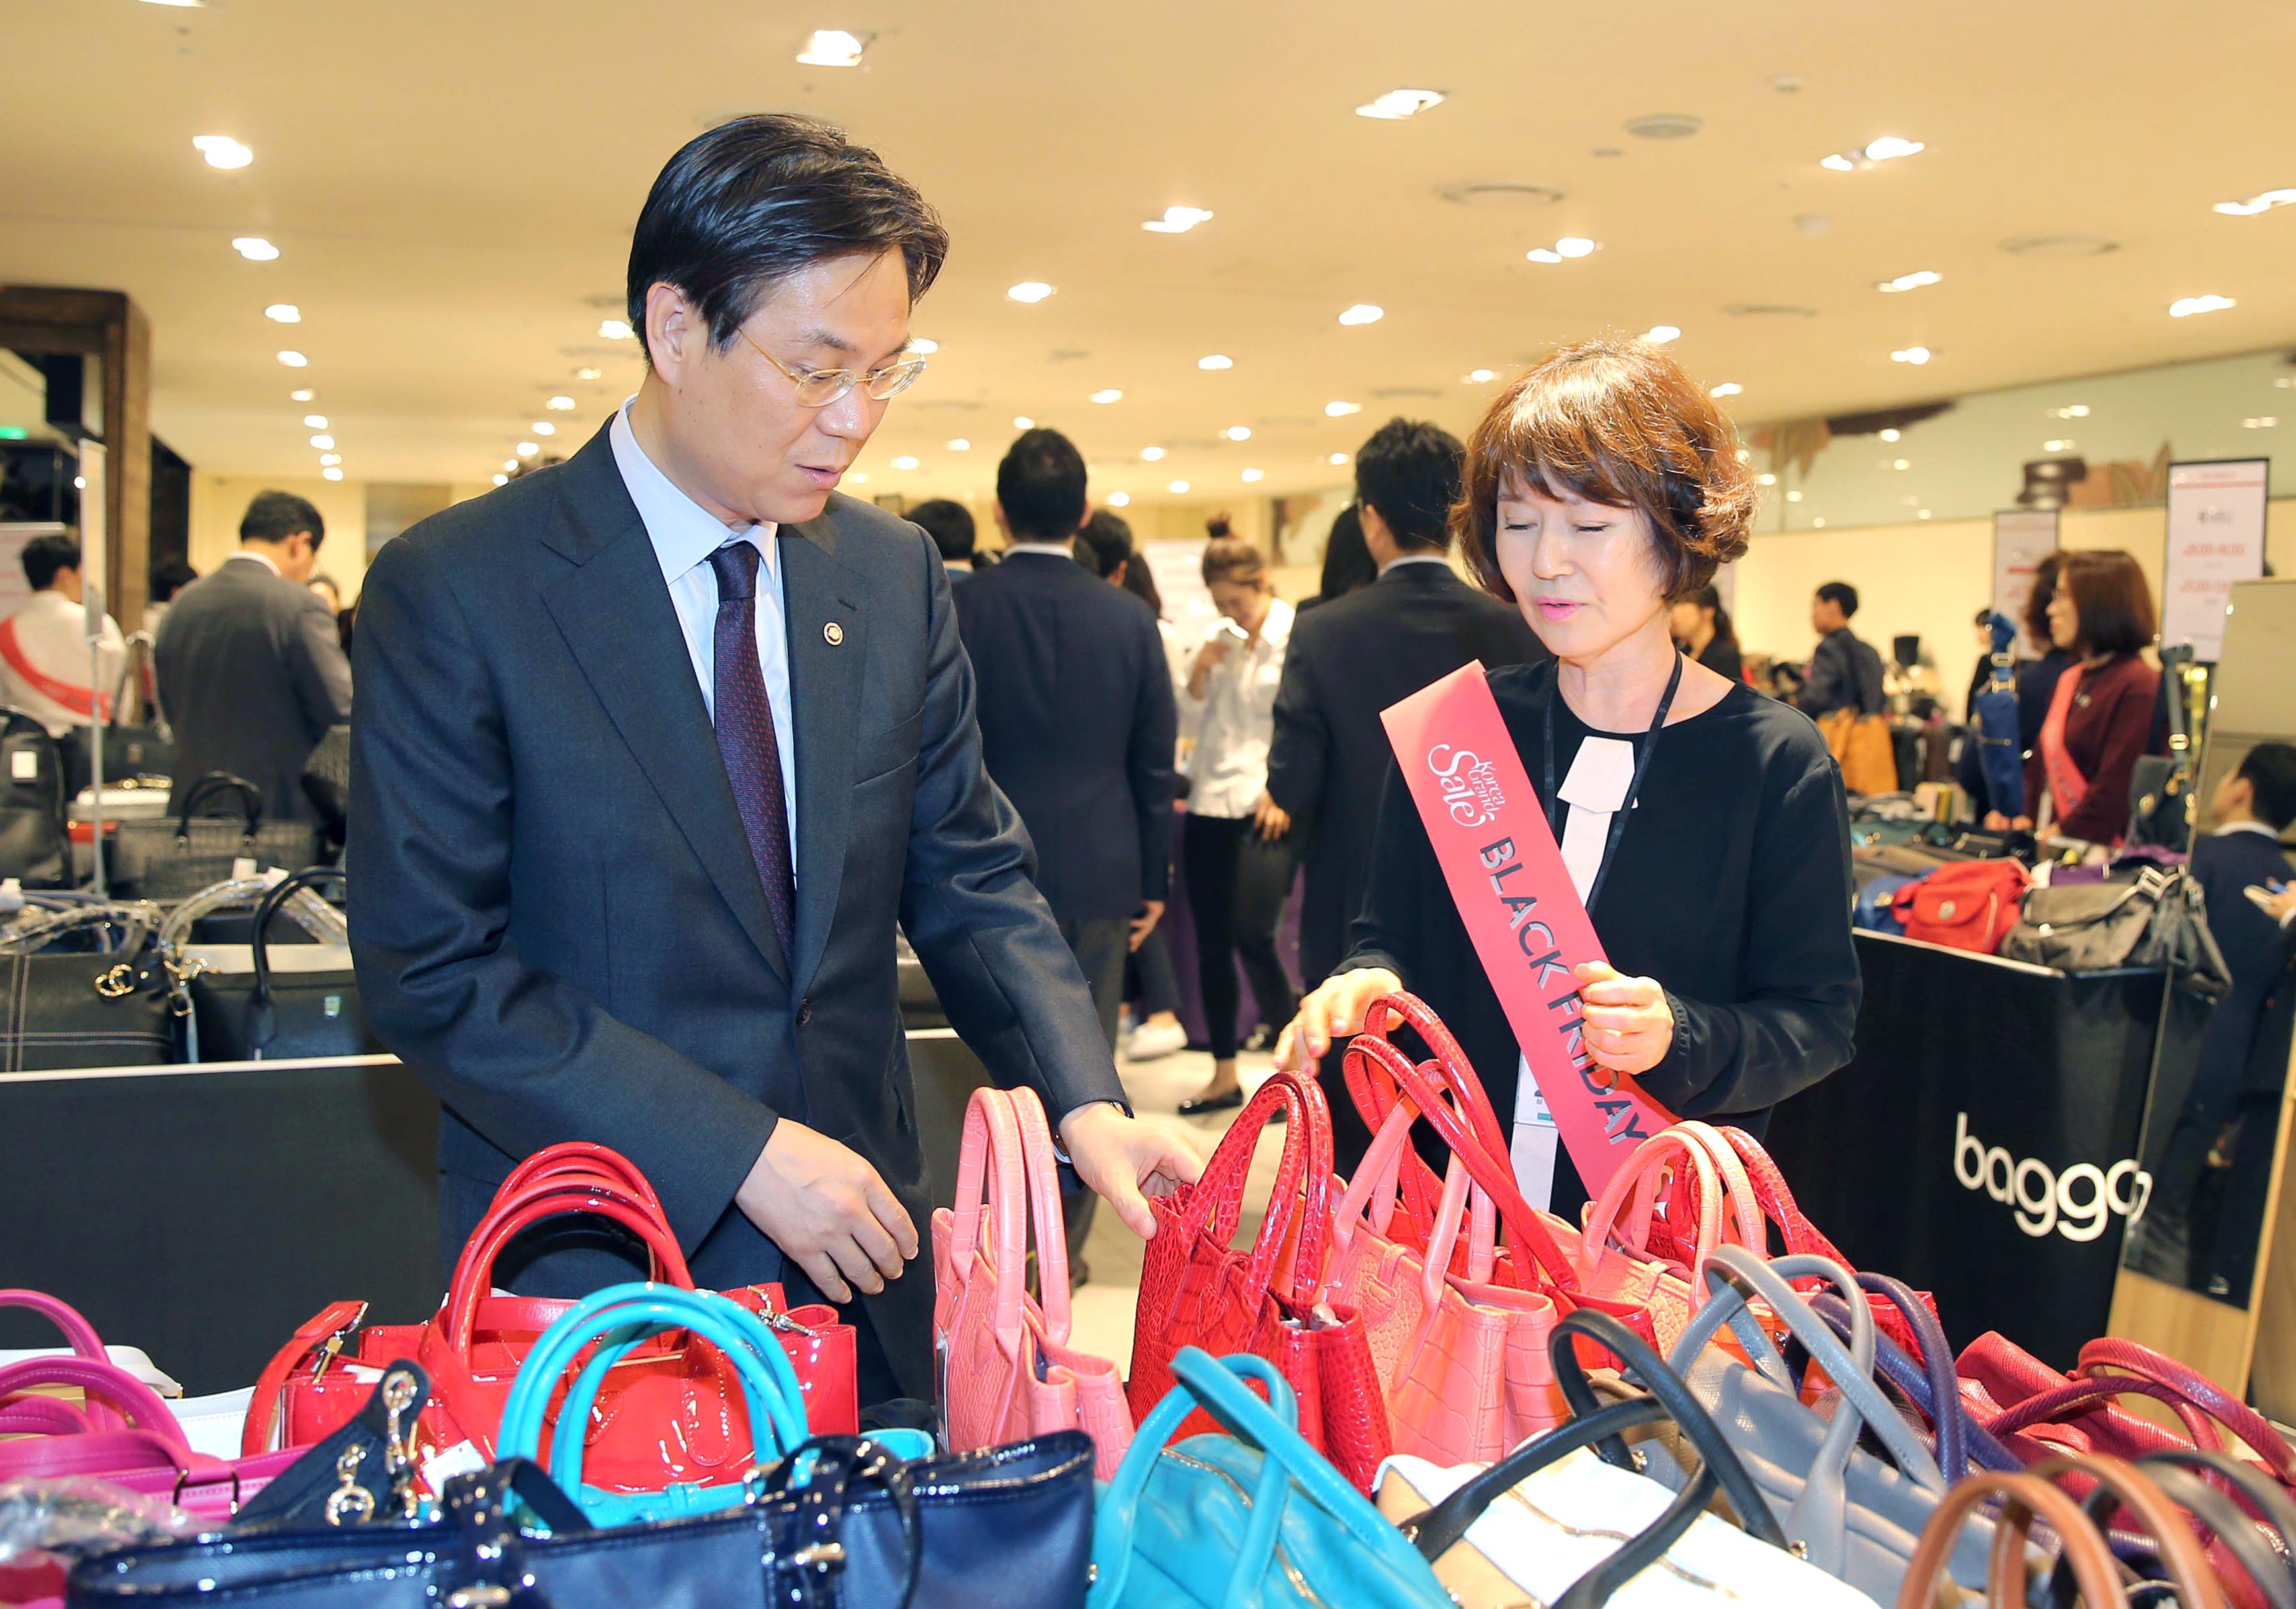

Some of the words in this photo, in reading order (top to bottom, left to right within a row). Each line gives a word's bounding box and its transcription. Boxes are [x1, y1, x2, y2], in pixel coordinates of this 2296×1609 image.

[1427, 743, 1486, 827] Sale
[1468, 769, 1500, 821] Grand
[1478, 761, 1506, 805] Korea
[1479, 836, 1570, 990] BLACK
